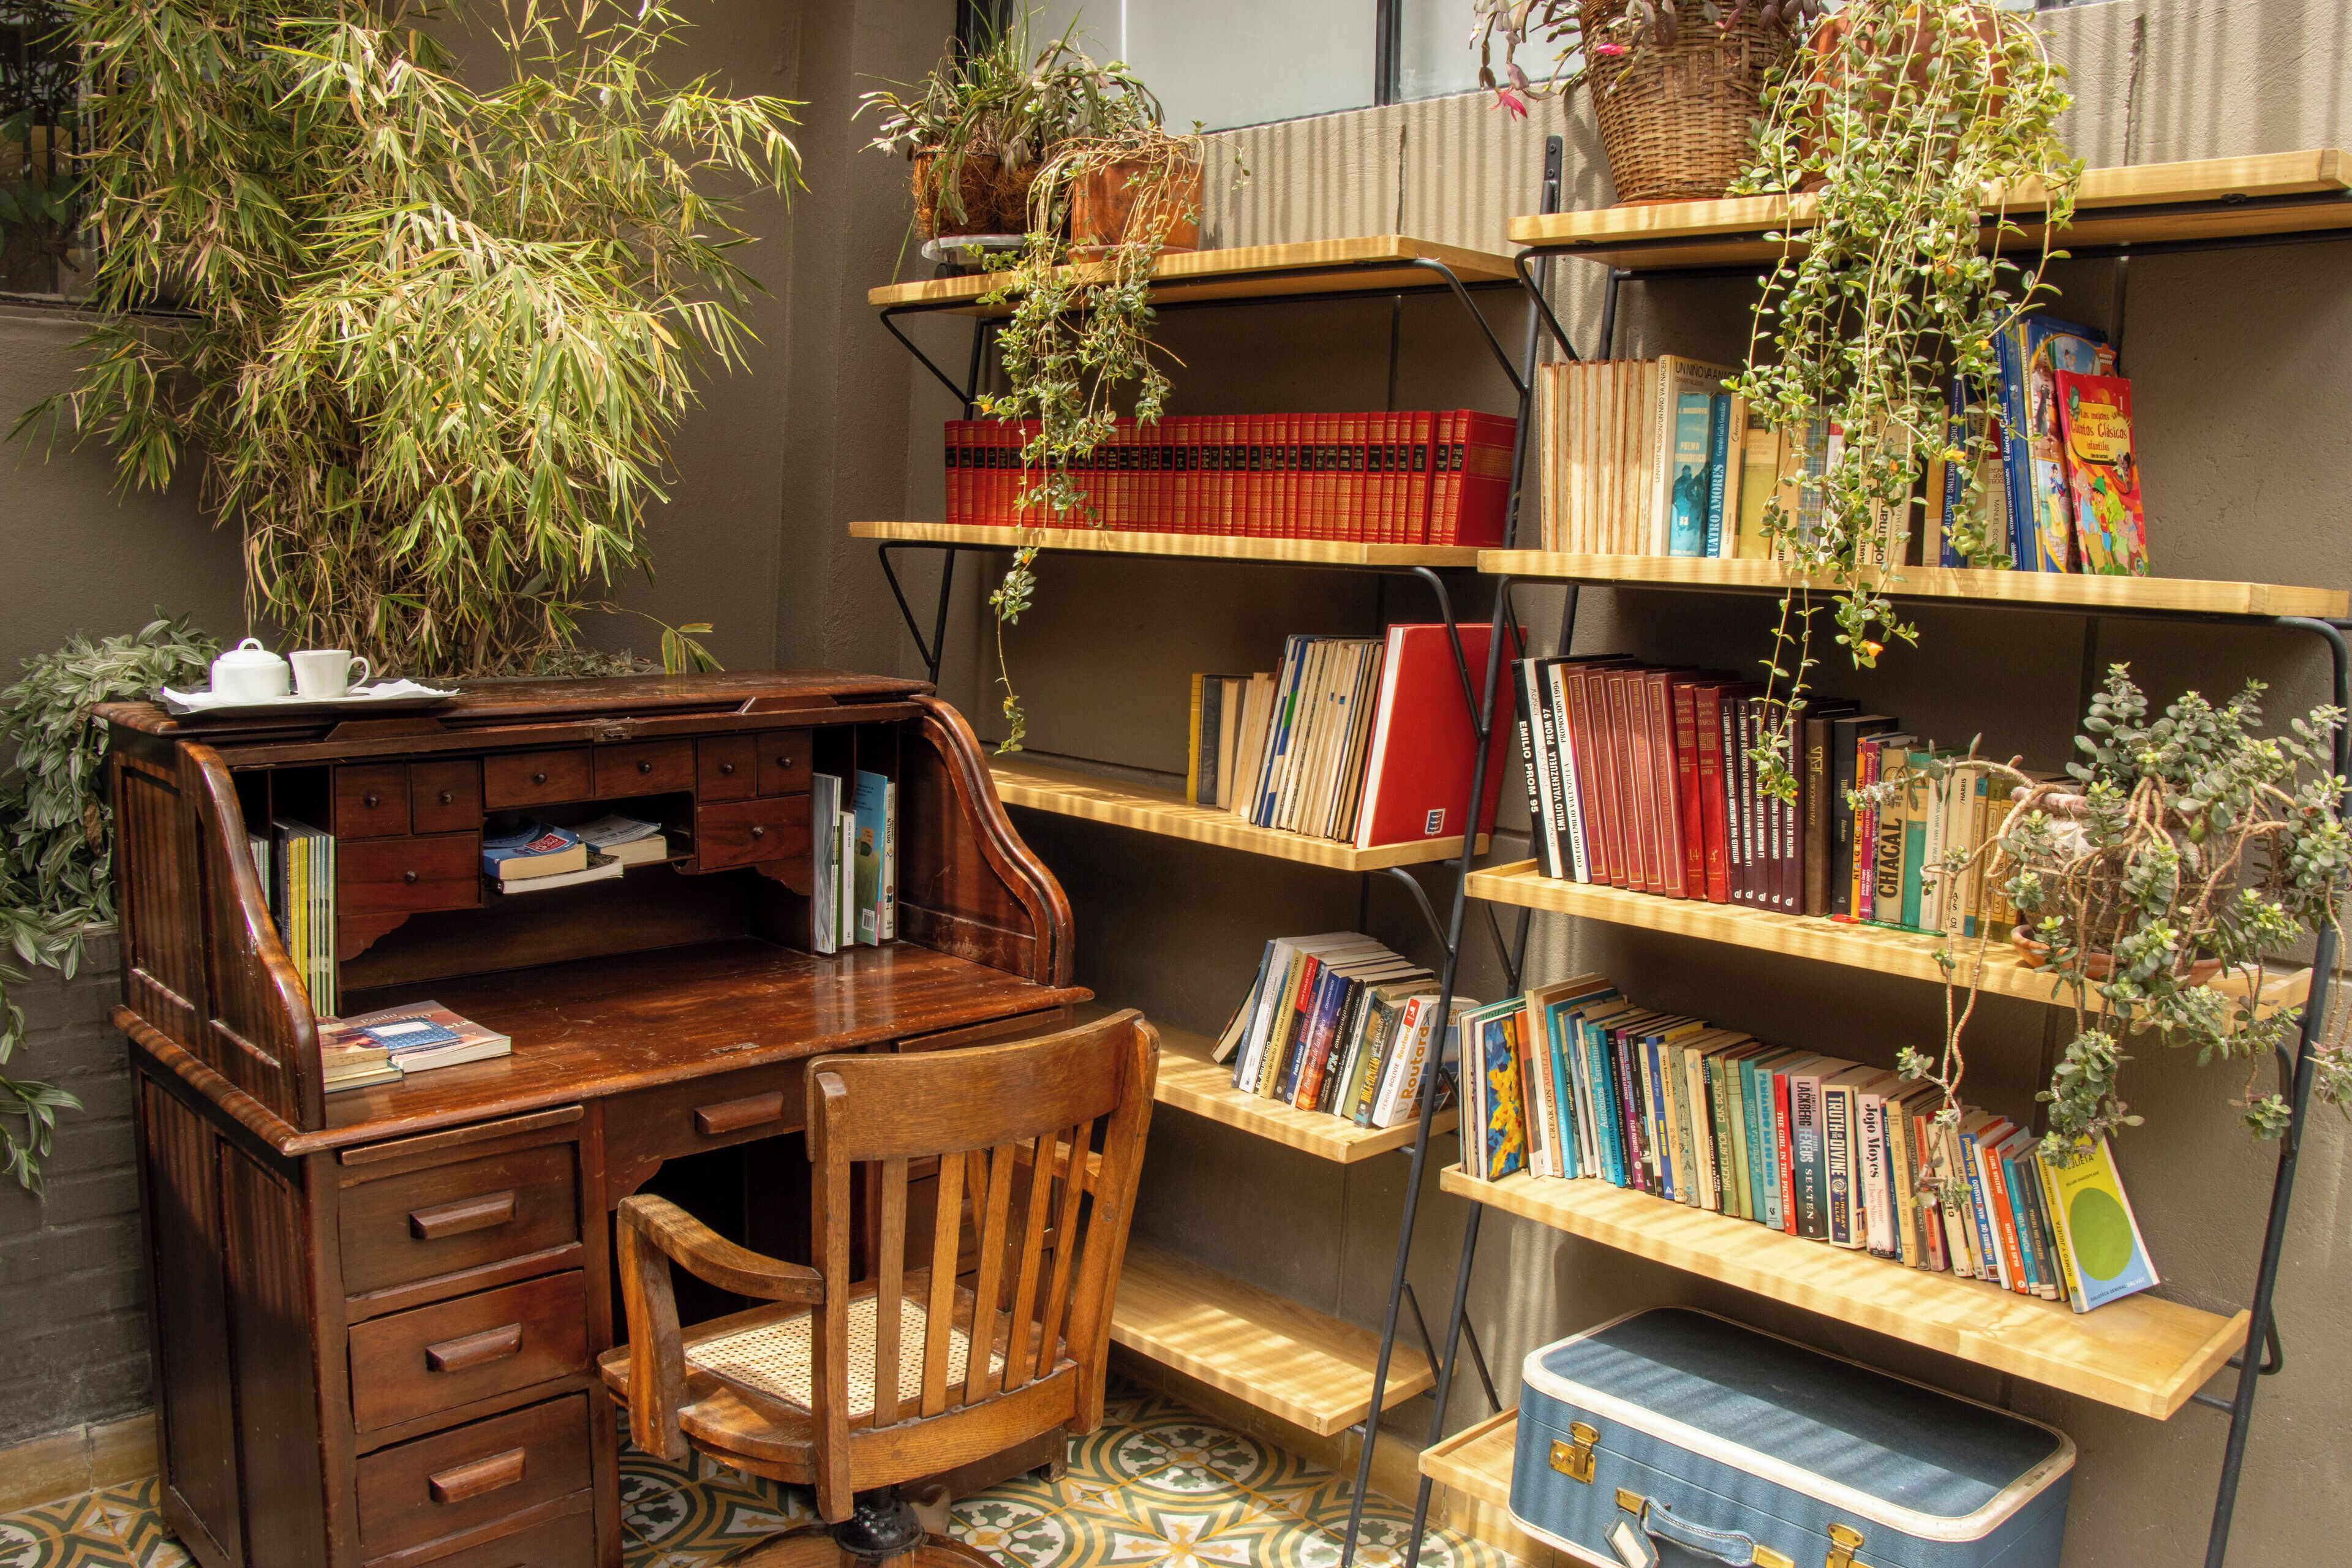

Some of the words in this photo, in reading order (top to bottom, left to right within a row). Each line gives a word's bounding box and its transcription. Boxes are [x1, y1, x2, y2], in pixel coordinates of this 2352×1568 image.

[2096, 422, 2127, 440] Clásicos
[1709, 464, 1725, 511] AMORES
[1552, 680, 1561, 698] 1994
[1573, 677, 1581, 703] norma
[1544, 720, 1555, 745] PROM
[1555, 700, 1567, 742] PROMOCION
[1518, 720, 1531, 759] EMILIO
[1524, 763, 1536, 795] PROM
[1548, 751, 1562, 801] VALENZUELA
[1563, 763, 1574, 808] VALENZUELA
[1727, 769, 1735, 797] PSICOMOTORA
[1529, 799, 1539, 813] 95
[1555, 802, 1566, 831] EMILIO
[1728, 799, 1737, 826] EJERCITACION
[1569, 809, 1578, 834] EMILIO
[1573, 835, 1583, 867] COLEGIO
[1689, 848, 1700, 861] 14
[1877, 817, 1902, 899] CHACAL
[1269, 1047, 1278, 1062] lucha
[1274, 1017, 1285, 1042] actividad
[1281, 986, 1293, 1017] empresarial
[1288, 957, 1299, 985] 1950/2000
[1324, 990, 1332, 1010] JONATHAN
[360, 1012, 398, 1024] Paulo
[1298, 1019, 1310, 1043] GUSTAVO
[1305, 991, 1316, 1018] CISNEROS
[1313, 1038, 1322, 1047] las
[1333, 1025, 1343, 1048] GONZALO
[1396, 1027, 1411, 1059] Routard
[1257, 1041, 1271, 1078] AGUILUCHO
[1295, 1045, 1305, 1063] Bachelet
[1306, 1055, 1317, 1077] encima
[1325, 1050, 1339, 1073] FM
[1400, 1024, 1431, 1101] Routard
[1588, 1032, 1603, 1083] Espirituales
[1388, 1063, 1400, 1087] BOLIVIE
[1541, 1050, 1551, 1087] ARCILLA
[1255, 1077, 1262, 1088] EL
[1303, 1076, 1312, 1088] Por
[1713, 1079, 1723, 1104] BERNE
[1605, 1088, 1613, 1119] CARTAS
[1716, 1106, 1725, 1123] ERIC
[1797, 1081, 1813, 1126] LÄCKBERG
[1828, 1096, 1844, 1131] TRUTH
[1547, 1107, 1556, 1139] CREAR
[1861, 1103, 1879, 1133] Jojo
[1718, 1131, 1728, 1155] AMOR
[1779, 1150, 1786, 1160] IN
[1798, 1128, 1813, 1163] FEXEUS
[1962, 1137, 1973, 1160] Norwood
[1830, 1139, 1846, 1176] DIVINE
[1866, 1137, 1880, 1177] Moyes
[1967, 1161, 1977, 1177] Robin
[1613, 1167, 1620, 1178] LA
[1993, 1170, 2003, 1195] JONATHAN
[1781, 1180, 1790, 1215] PICTURE
[2016, 1213, 2026, 1227] VUH
[2029, 1208, 2037, 1228] TIERRA
[2005, 1223, 2015, 1244] GULLIVER
[2020, 1229, 2030, 1253] POPOL
[2056, 1221, 2066, 1246] JULIETA
[2035, 1239, 2044, 1259] SIERVO
[2063, 1253, 2073, 1276] ROMEO
[2089, 1290, 2110, 1302] BIBLIOTECA
[2109, 1284, 2127, 1295] GENERAL
[2126, 1277, 2145, 1287] SALVAT
